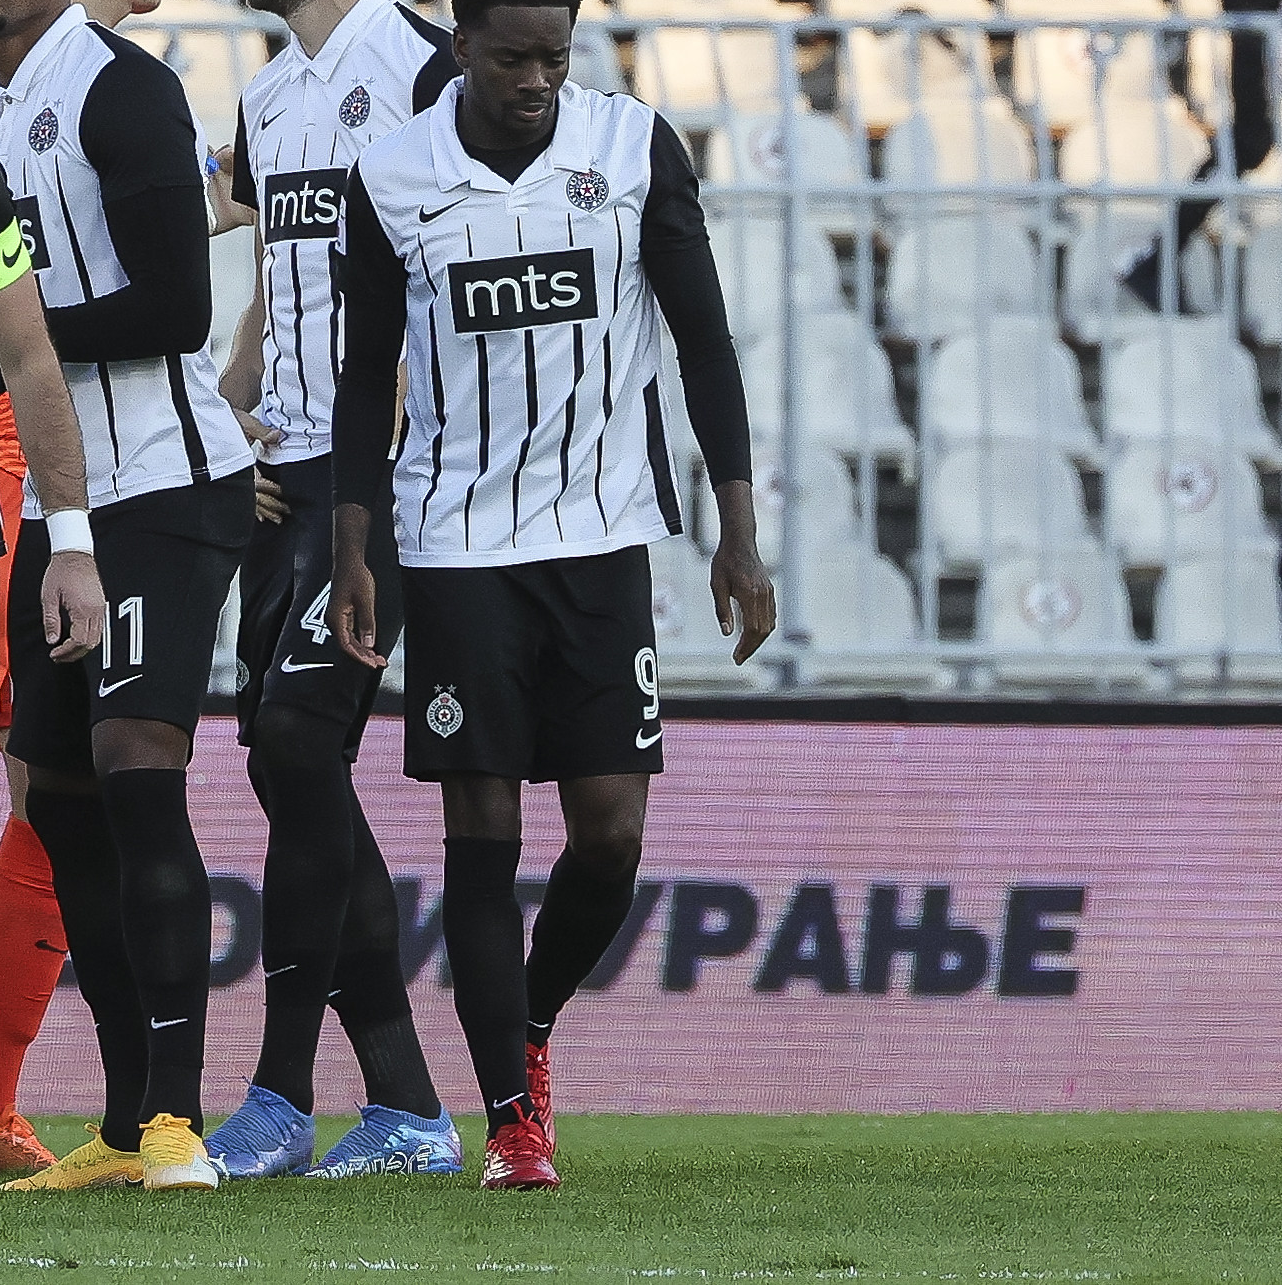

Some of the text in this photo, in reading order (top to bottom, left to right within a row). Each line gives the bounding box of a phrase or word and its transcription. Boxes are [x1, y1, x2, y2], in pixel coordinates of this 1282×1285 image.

[270, 181, 337, 229] mts
[464, 263, 580, 318] mts
[299, 579, 333, 645] 4
[634, 646, 661, 720] 9
[205, 869, 1087, 1000] ОУРАЊЕ
